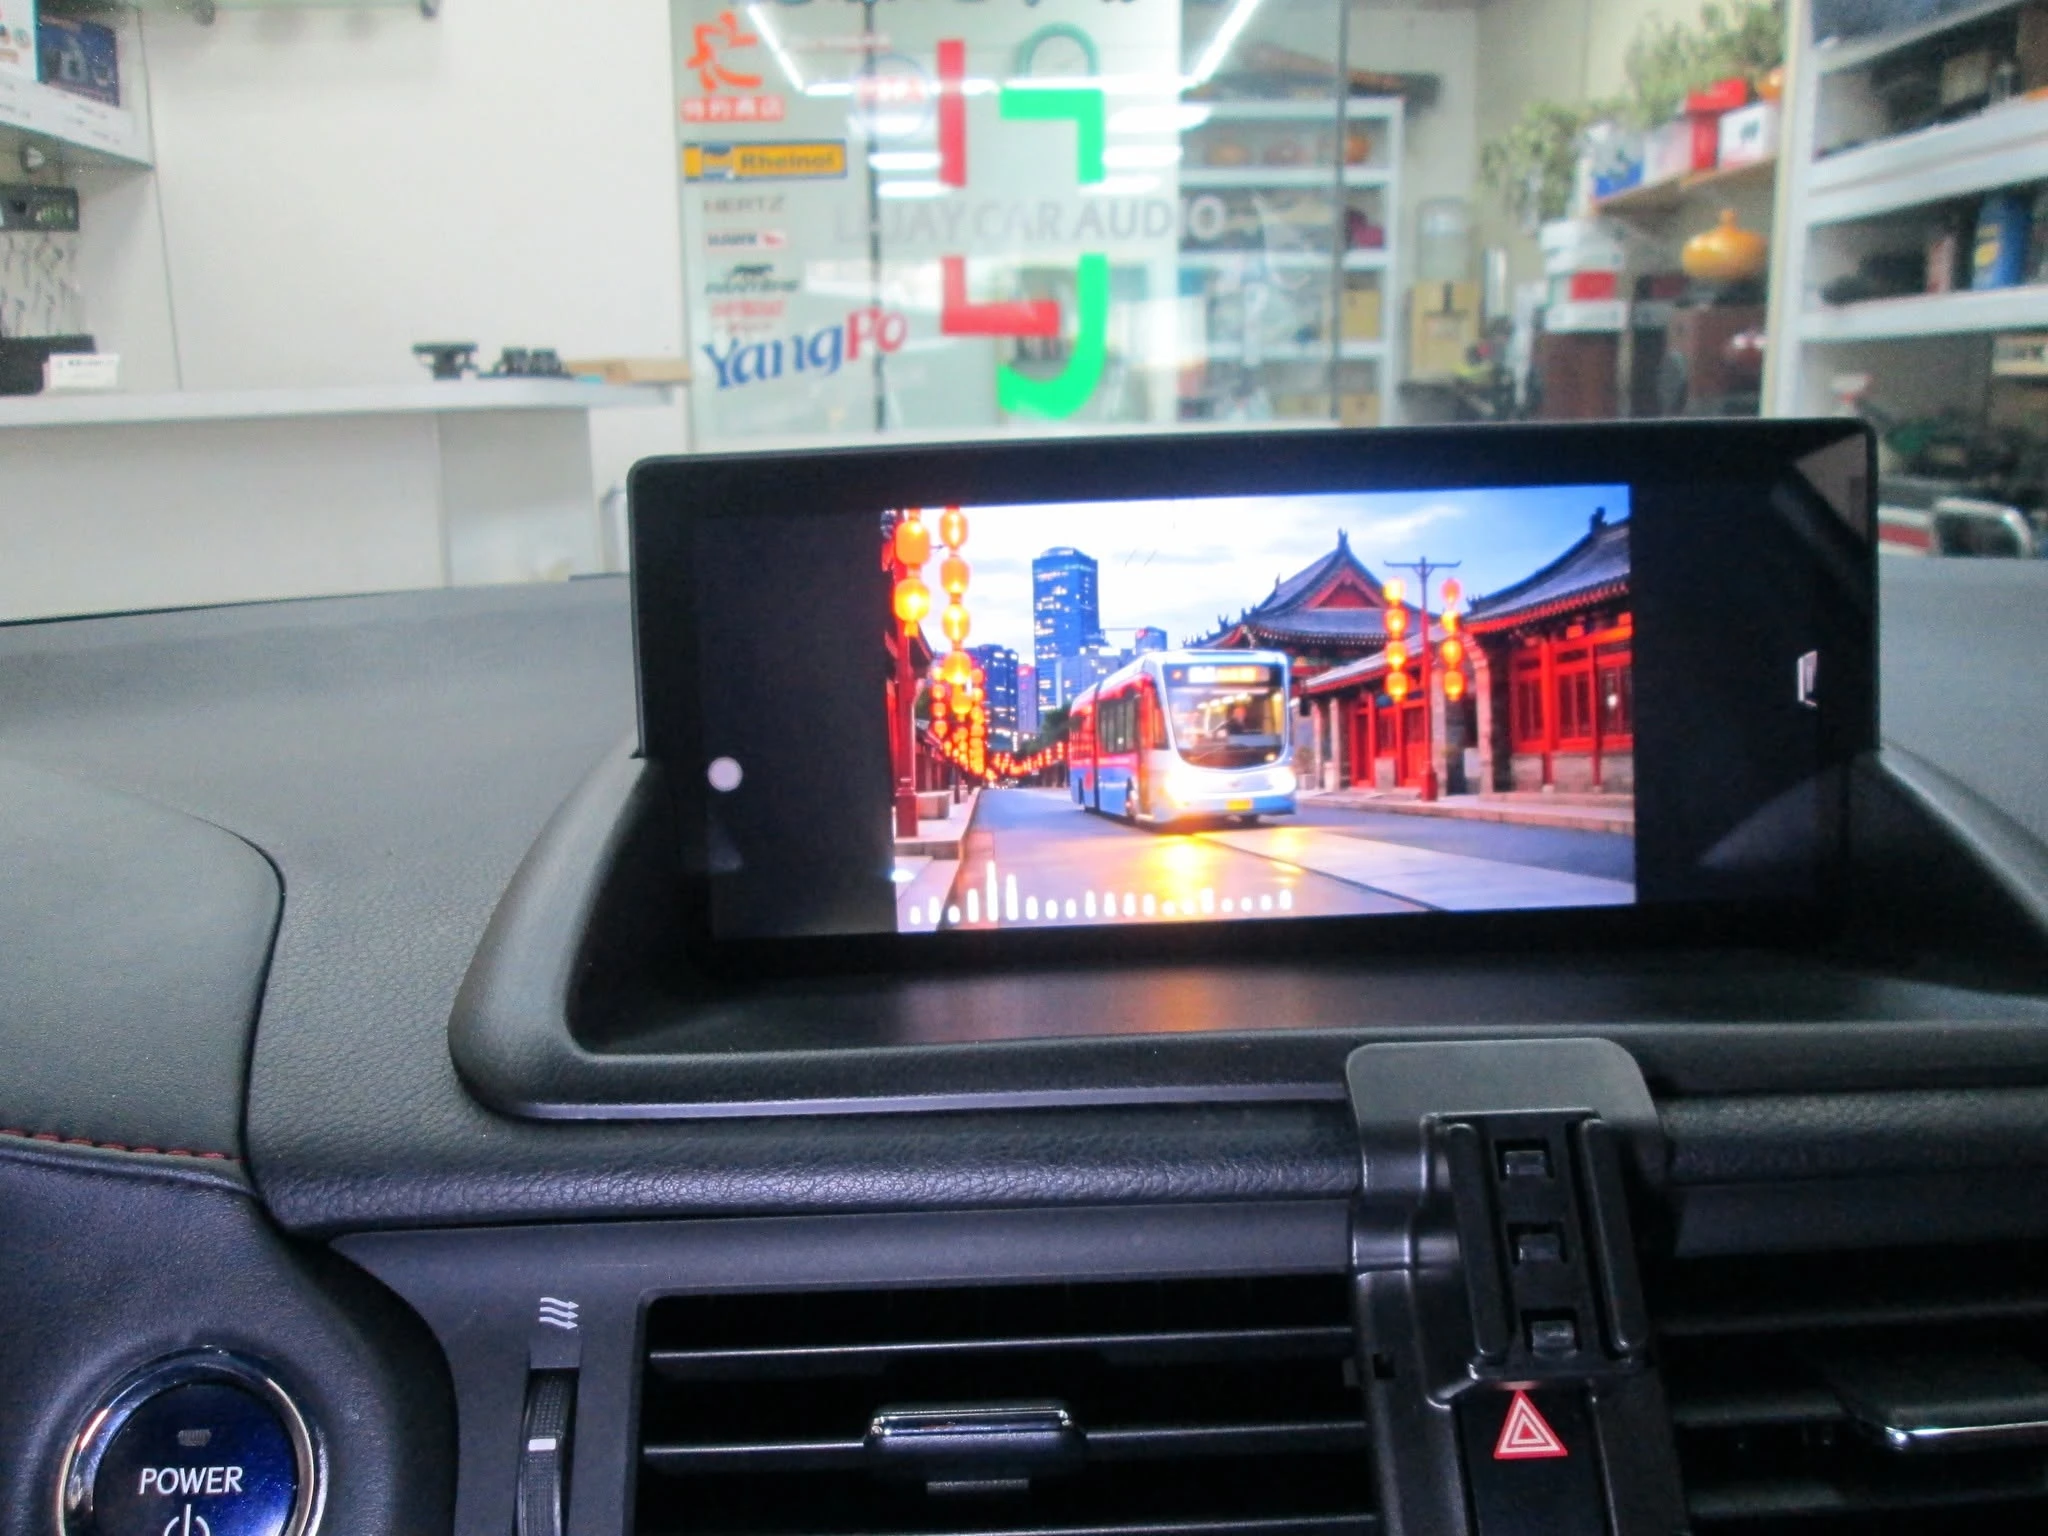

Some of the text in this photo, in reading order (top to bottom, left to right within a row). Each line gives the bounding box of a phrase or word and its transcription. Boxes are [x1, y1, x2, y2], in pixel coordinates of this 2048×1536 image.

[740, 152, 835, 169] Rheinol
[703, 194, 787, 213] HERTZ
[970, 200, 1061, 241] CAR
[1073, 194, 1227, 241] AUDIO
[701, 306, 908, 389] YangPo
[138, 1466, 243, 1495] POWER
